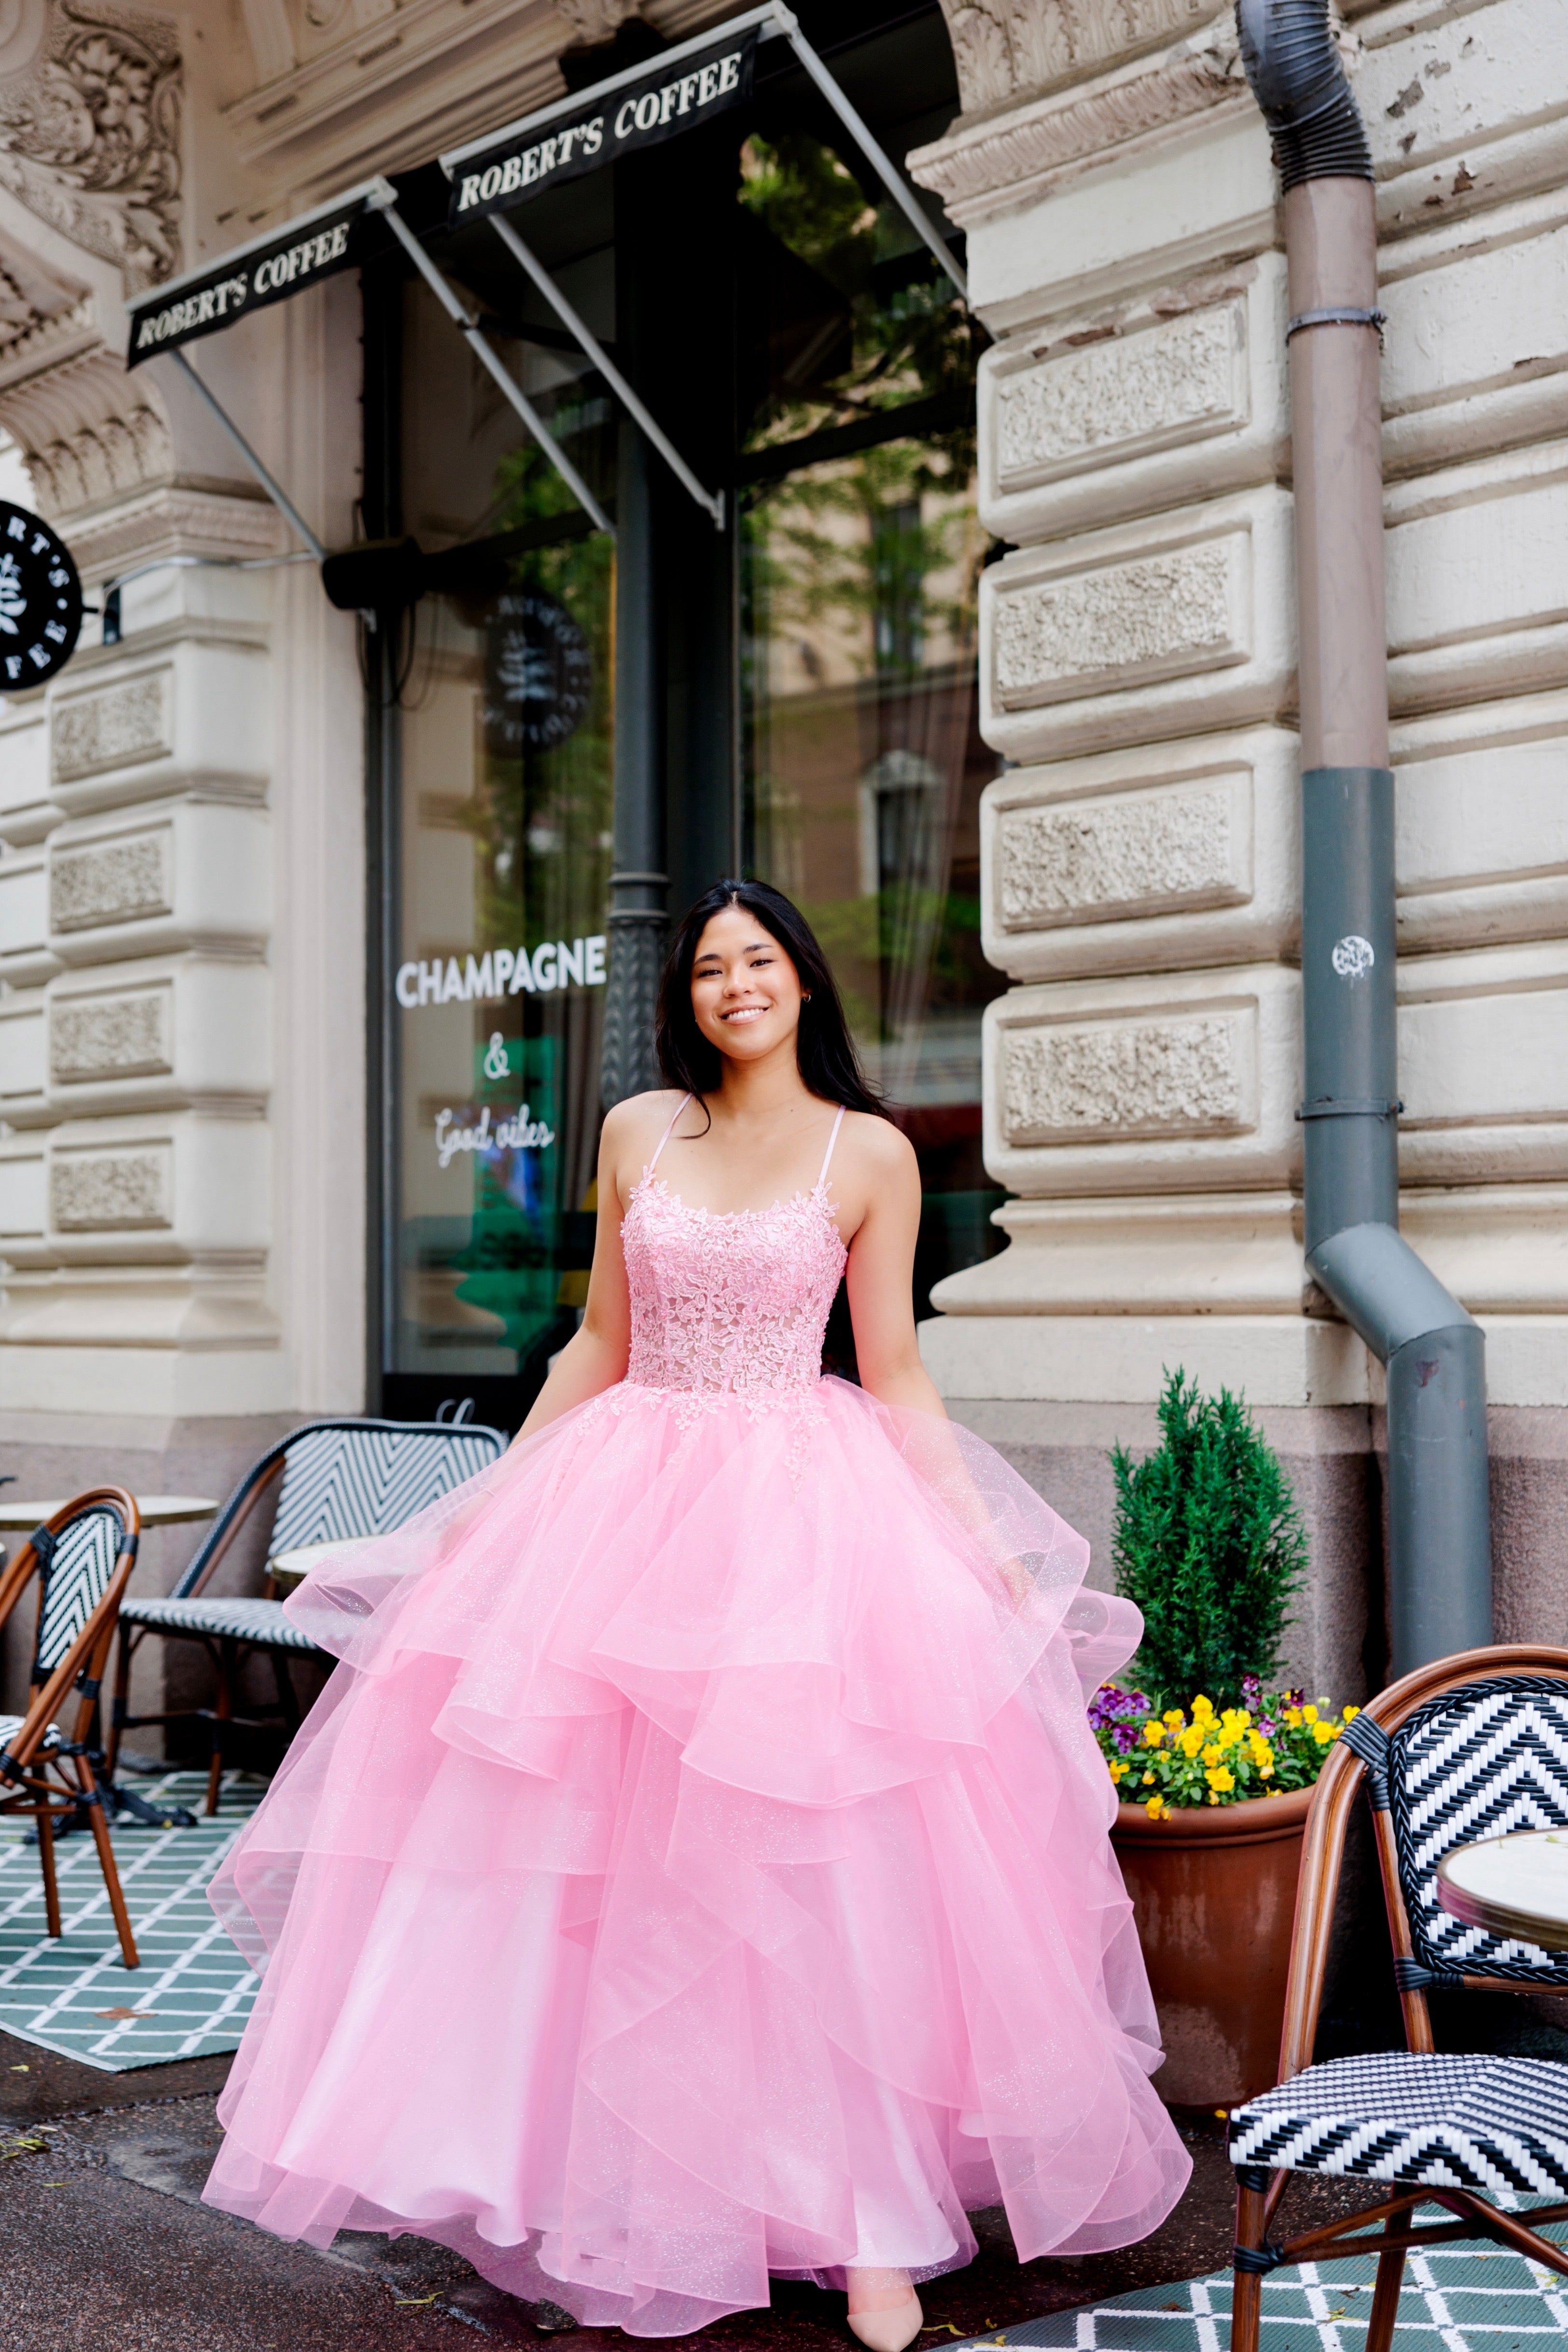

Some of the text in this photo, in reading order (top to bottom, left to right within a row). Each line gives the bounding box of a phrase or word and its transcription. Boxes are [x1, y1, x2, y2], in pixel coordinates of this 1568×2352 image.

[458, 52, 741, 212] ROBERT'S COFFEE
[137, 222, 350, 349] ROBERT'S COFFEE
[7, 515, 70, 588] RT'S
[5, 620, 68, 680] FEE
[395, 935, 607, 1009] CHAMPAGNE
[484, 1031, 511, 1080] &
[435, 1103, 555, 1169] Good vibes
